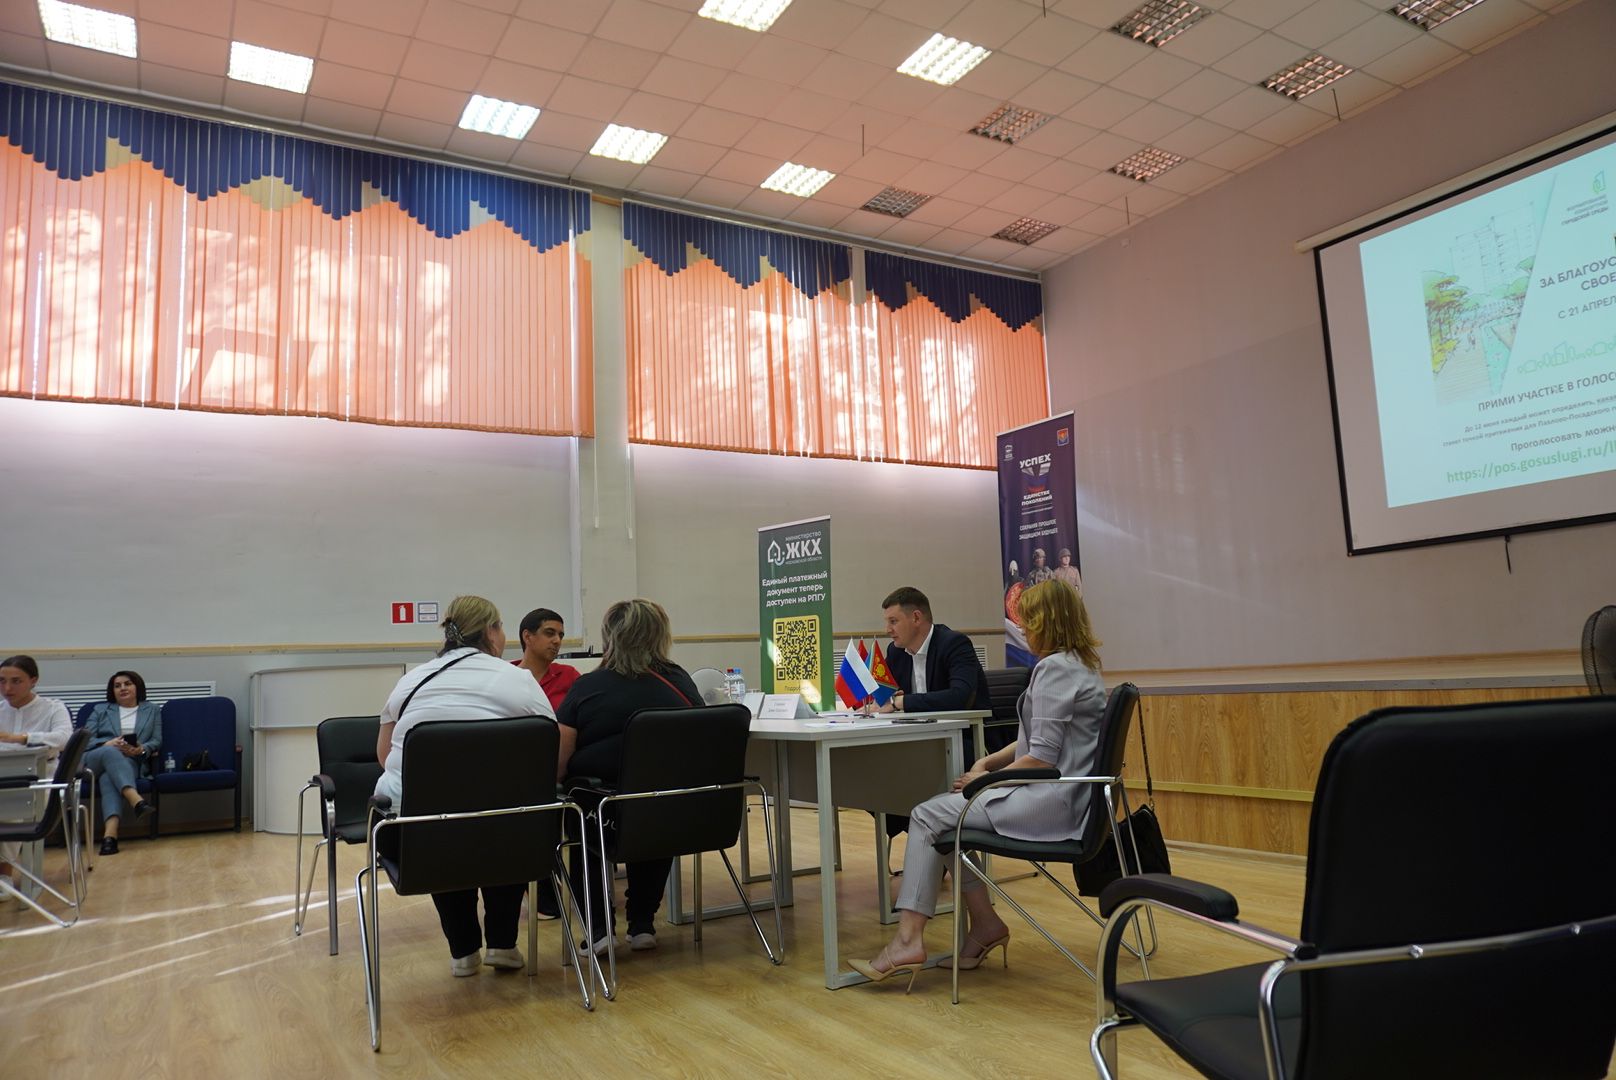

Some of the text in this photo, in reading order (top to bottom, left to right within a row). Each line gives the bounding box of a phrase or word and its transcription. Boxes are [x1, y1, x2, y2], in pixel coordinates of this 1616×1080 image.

[1540, 256, 1616, 289] ЗА БЛАГОУС
[1581, 272, 1616, 291] СВОЕ
[1558, 310, 1567, 320] С
[1569, 306, 1579, 317] 21
[1478, 396, 1516, 412] ПРИМИ
[1567, 381, 1575, 391] В
[1511, 424, 1616, 452] Проголосовать можн
[1020, 453, 1051, 469] УСПЕХ
[785, 538, 823, 560] ЖКХ
[762, 570, 829, 587] Единый платежный
[766, 583, 824, 597] документ теперь
[766, 592, 826, 607] доступен на РПГУ
[784, 684, 809, 693] Подроб
